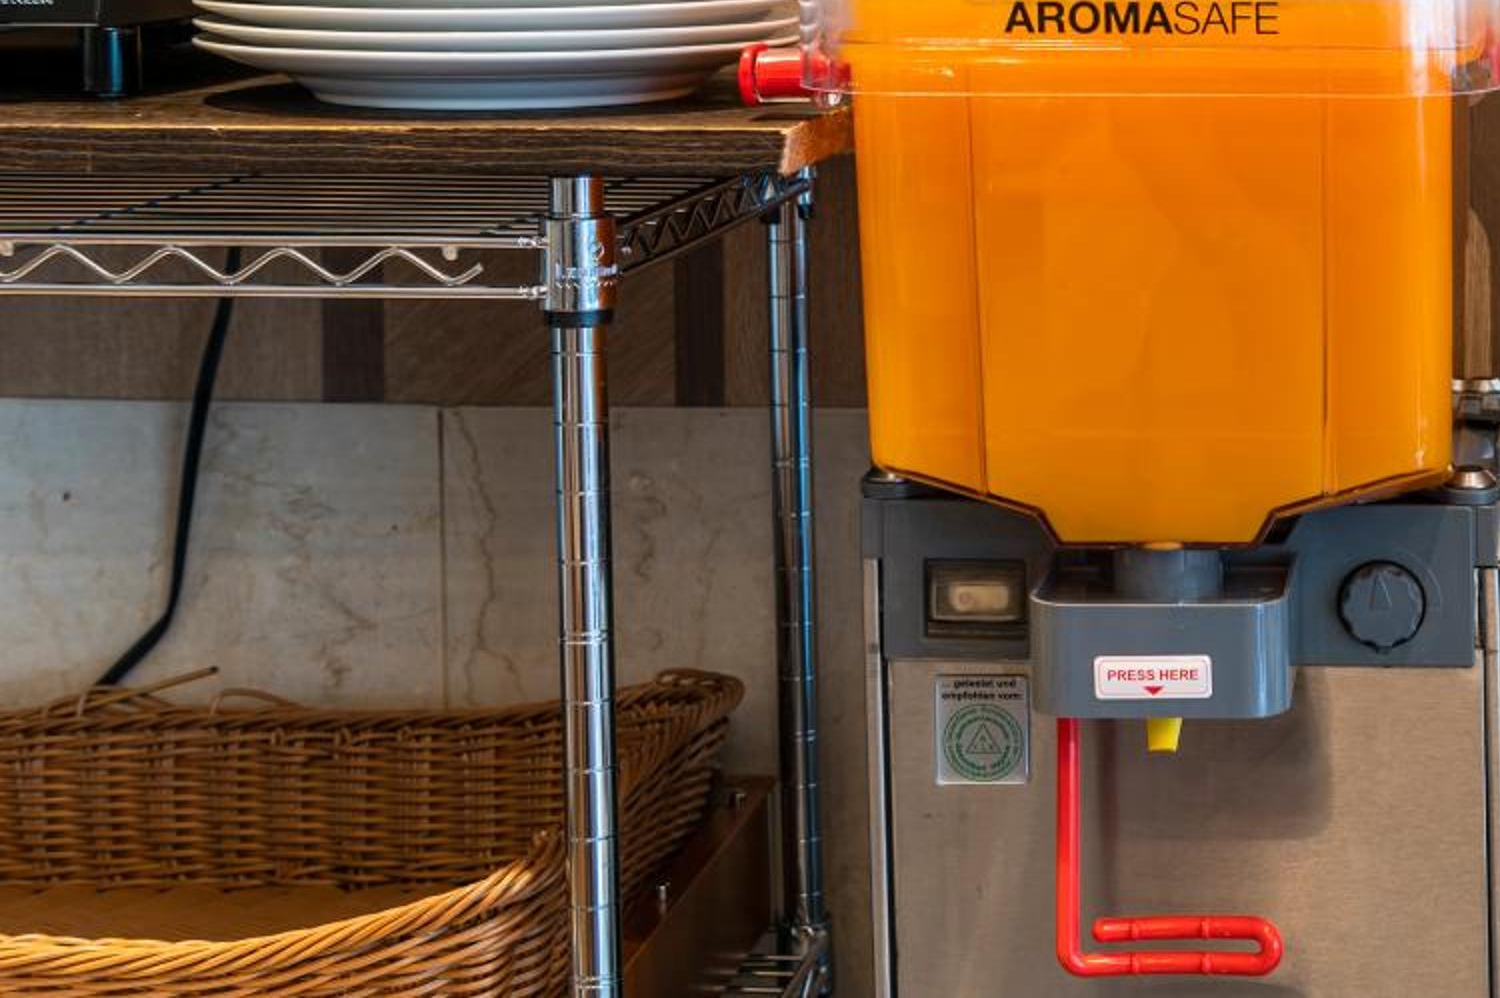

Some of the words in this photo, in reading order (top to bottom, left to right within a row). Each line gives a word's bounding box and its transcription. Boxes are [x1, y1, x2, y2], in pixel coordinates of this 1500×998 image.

[1004, 1, 1280, 36] AROMASAFE
[1107, 669, 1155, 681] PRESS
[1159, 669, 1199, 681] HERE
